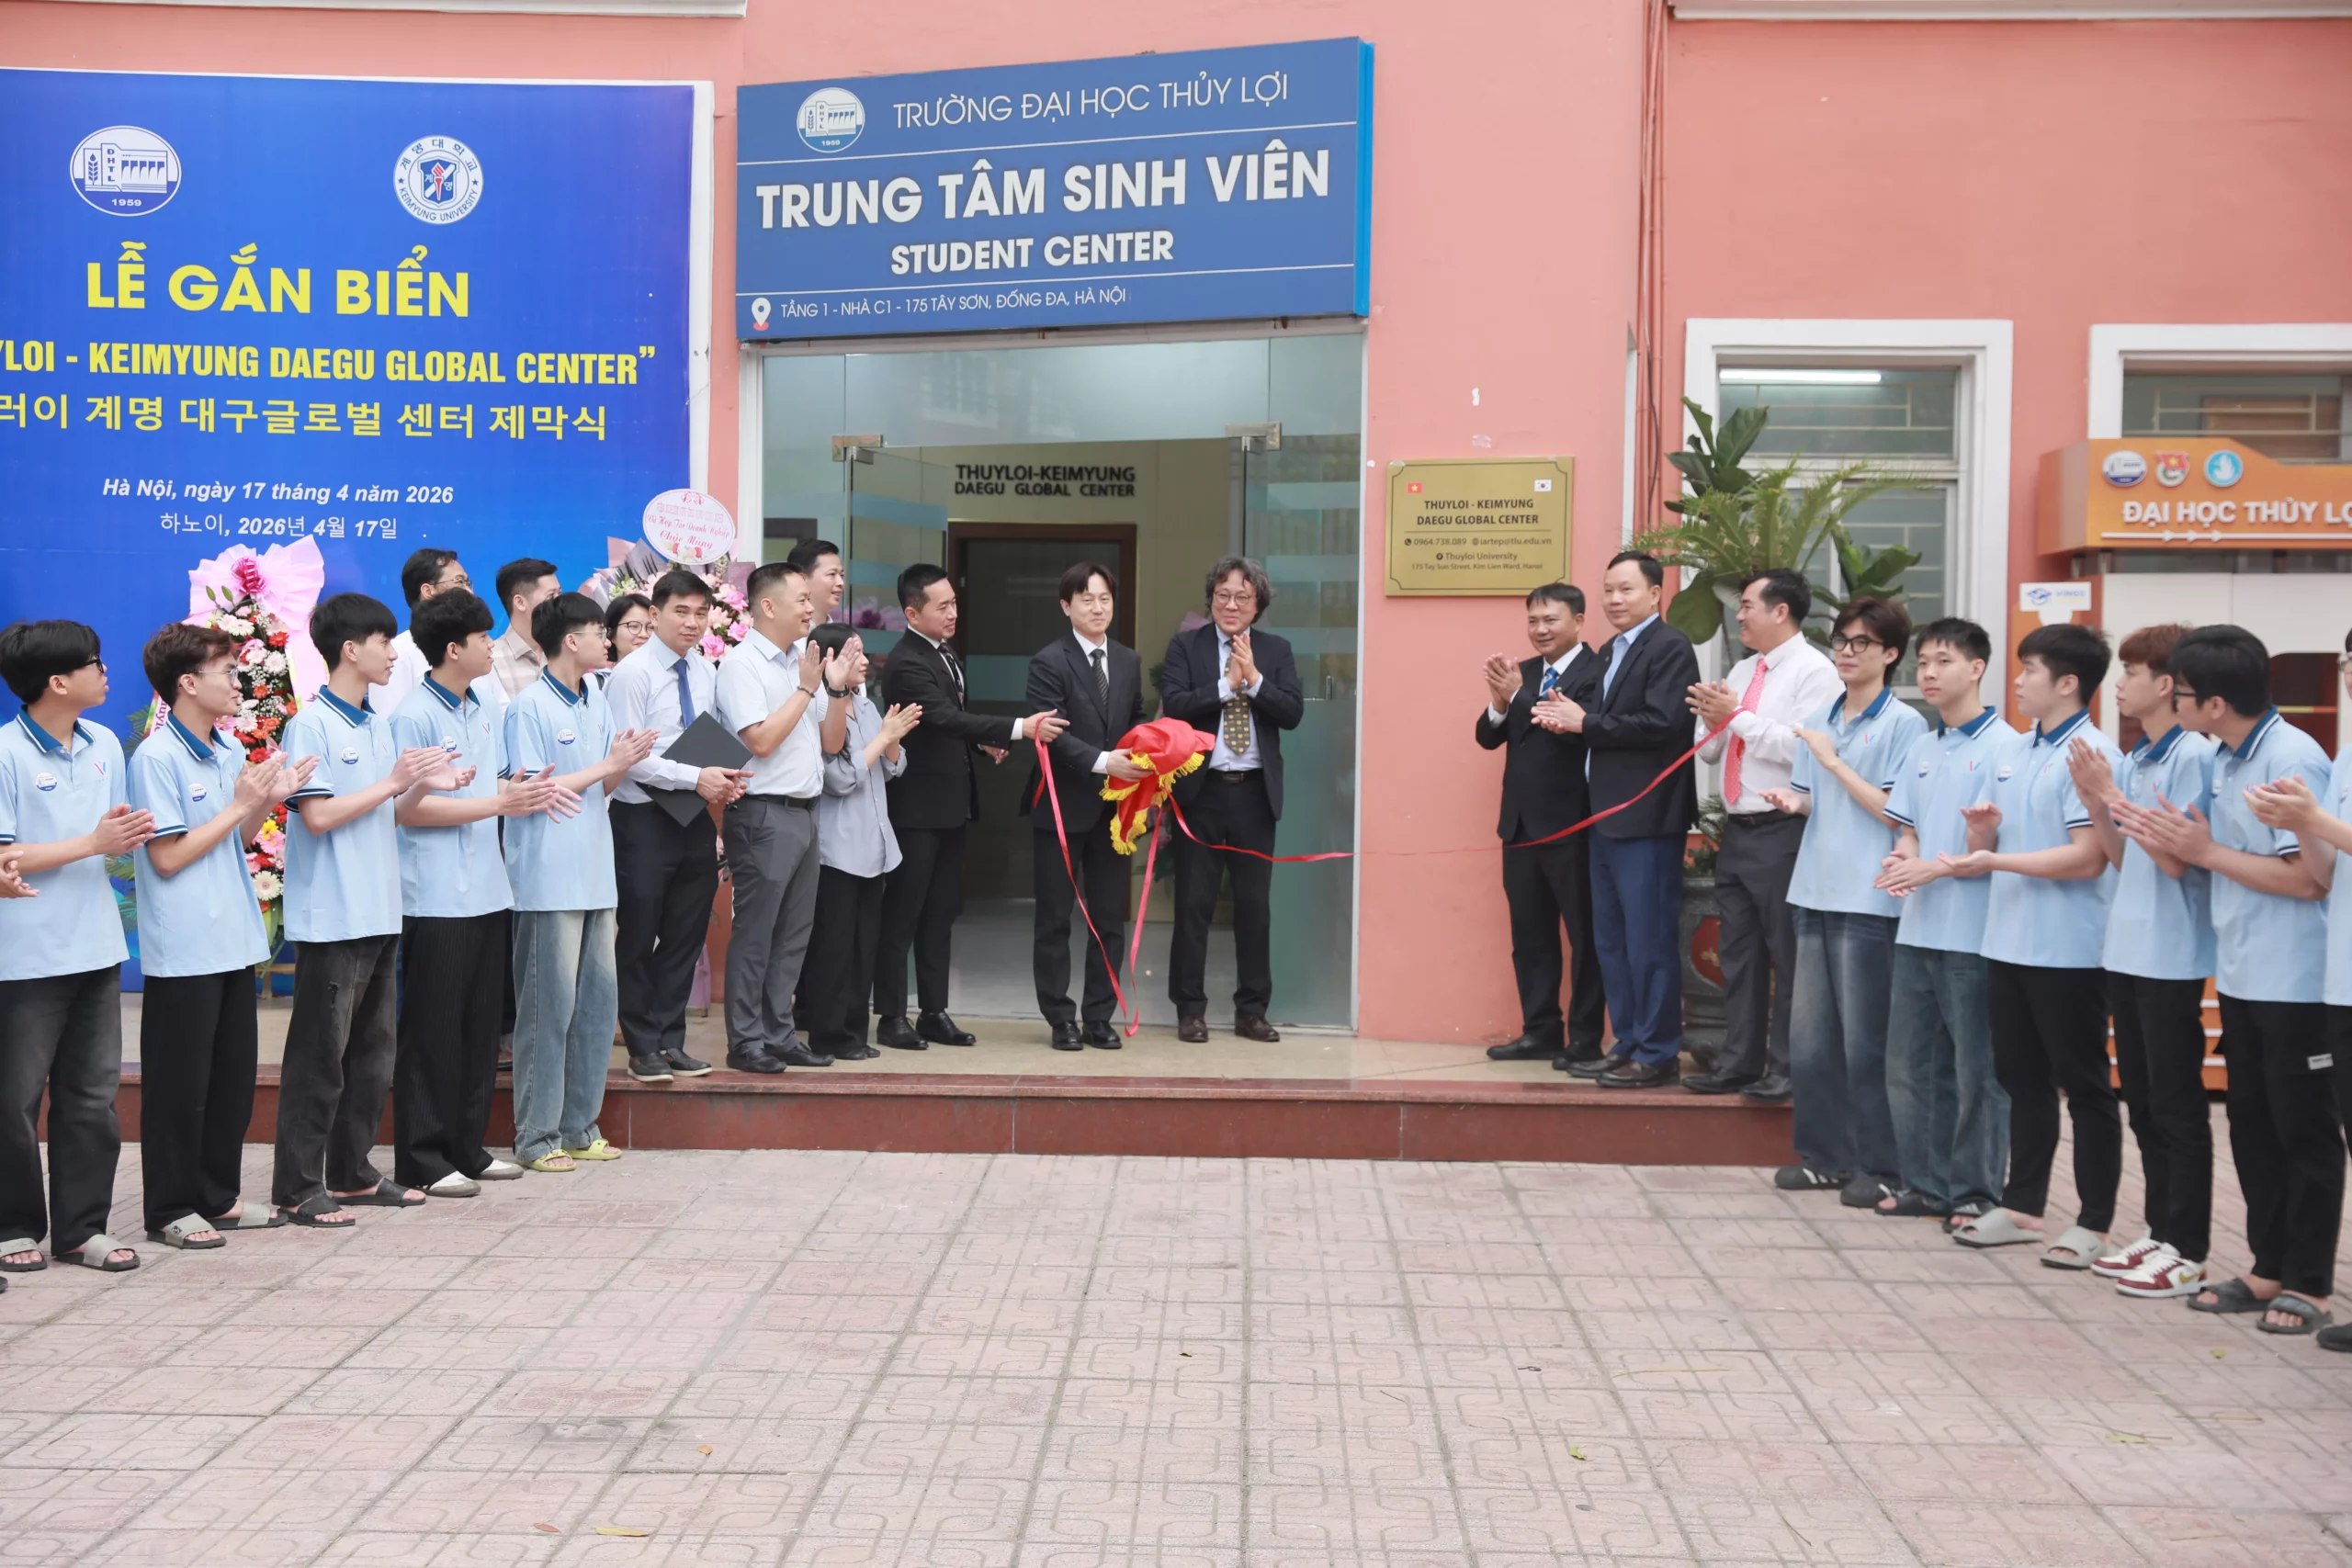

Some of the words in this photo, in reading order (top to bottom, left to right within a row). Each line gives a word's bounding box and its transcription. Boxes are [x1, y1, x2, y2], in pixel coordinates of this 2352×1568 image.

[894, 94, 1012, 128] TRƯỜNG
[1022, 91, 1069, 122] ĐẠI
[1081, 85, 1149, 118] HỌC
[1159, 72, 1231, 107] THỦY
[1242, 72, 1286, 107] LỢI
[757, 177, 922, 228] TRUNG
[939, 159, 1045, 219] TÂM
[1064, 159, 1185, 211] SINH
[1204, 140, 1330, 202] VIÊN
[111, 198, 142, 207] 1959
[399, 186, 437, 221] KEIMYUNG
[439, 189, 479, 221] UNIVERSITY
[892, 239, 1033, 274] STUDENT
[1045, 231, 1173, 265] CENTER
[88, 242, 146, 309] LỄ
[169, 243, 310, 313] GẮN
[337, 245, 468, 317] BIỂN
[781, 299, 818, 317] TẦNG
[823, 303, 827, 316] 1
[842, 299, 870, 315] NHÀ
[875, 300, 890, 313] C1
[907, 299, 927, 312] 175
[931, 295, 956, 310] TÂY
[959, 294, 991, 310] SƠN,
[997, 289, 1041, 308] ĐỐNG
[1046, 292, 1069, 305] ĐA,
[1076, 288, 1095, 304] HÀ
[1100, 286, 1125, 305] NỘI
[0, 340, 54, 371] LOI
[90, 343, 258, 377] KEIMYUNG
[271, 347, 374, 379] DAEGU
[386, 350, 505, 382] GLOBAL
[85, 396, 162, 430] 계명
[181, 399, 380, 435] 대구글로벌
[397, 404, 472, 438] 센터
[490, 405, 605, 440] 제막식
[956, 464, 1136, 482] THUYLOI-KEIMYUNG
[103, 479, 130, 495] Hà
[137, 479, 176, 500] Nội,
[185, 481, 235, 502] ngày
[243, 482, 266, 499] 17
[272, 483, 330, 504] tháng
[336, 485, 348, 501] 4
[355, 485, 399, 502] năm
[406, 486, 453, 503] 2026
[956, 482, 1004, 495] DAEGU
[1015, 483, 1070, 496] GLOBAL
[1080, 483, 1135, 497] CENTER
[1425, 501, 1468, 509] THUYLOI
[1477, 500, 1532, 508] KEIMYUNG
[2123, 502, 2169, 526] ĐẠI
[2177, 501, 2236, 526] HỌC
[2244, 497, 2317, 522] THỦY
[161, 513, 230, 536] 하노이,
[237, 515, 305, 538] 2026년
[312, 516, 345, 538] 4월
[356, 518, 396, 538] 17일
[1418, 516, 1452, 525] DAEGU
[1455, 515, 1495, 525] GLOBAL
[1498, 515, 1538, 524] CENTER
[1444, 552, 1476, 561] Thuyloi
[1476, 551, 1518, 561] University
